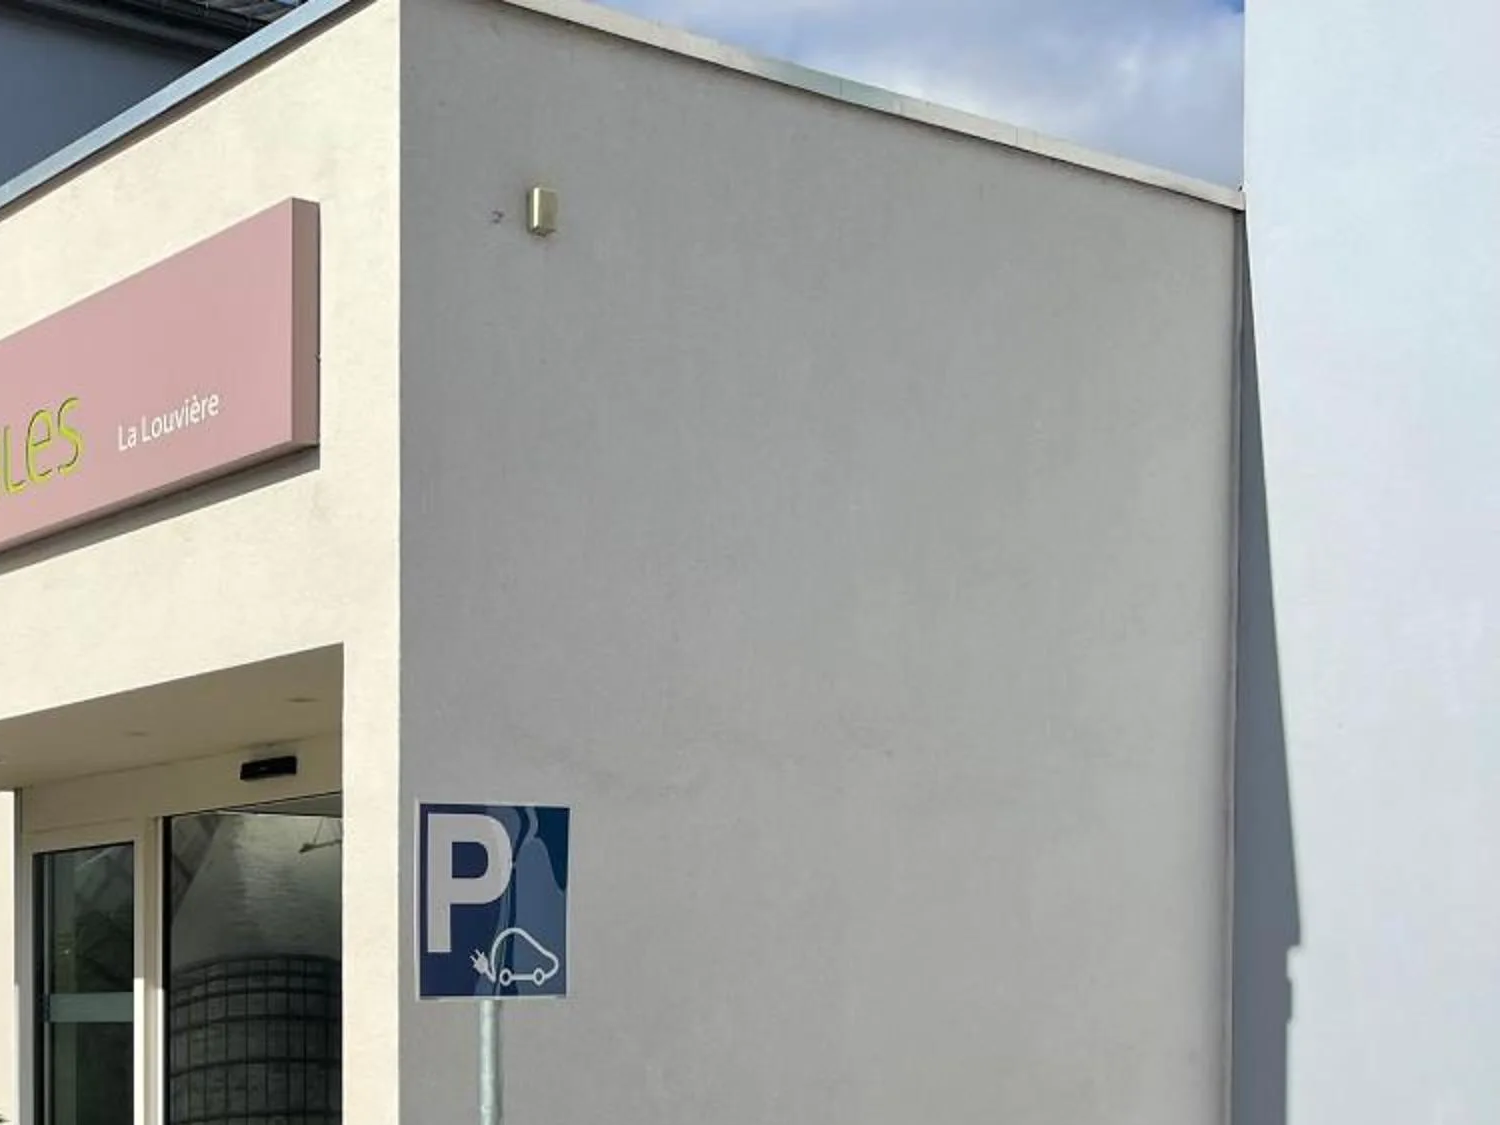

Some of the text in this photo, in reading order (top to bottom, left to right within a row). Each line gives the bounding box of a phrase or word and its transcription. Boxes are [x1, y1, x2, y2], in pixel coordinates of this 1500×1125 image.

[118, 424, 137, 451] La
[141, 394, 219, 442] Louvière
[427, 813, 513, 952] P
